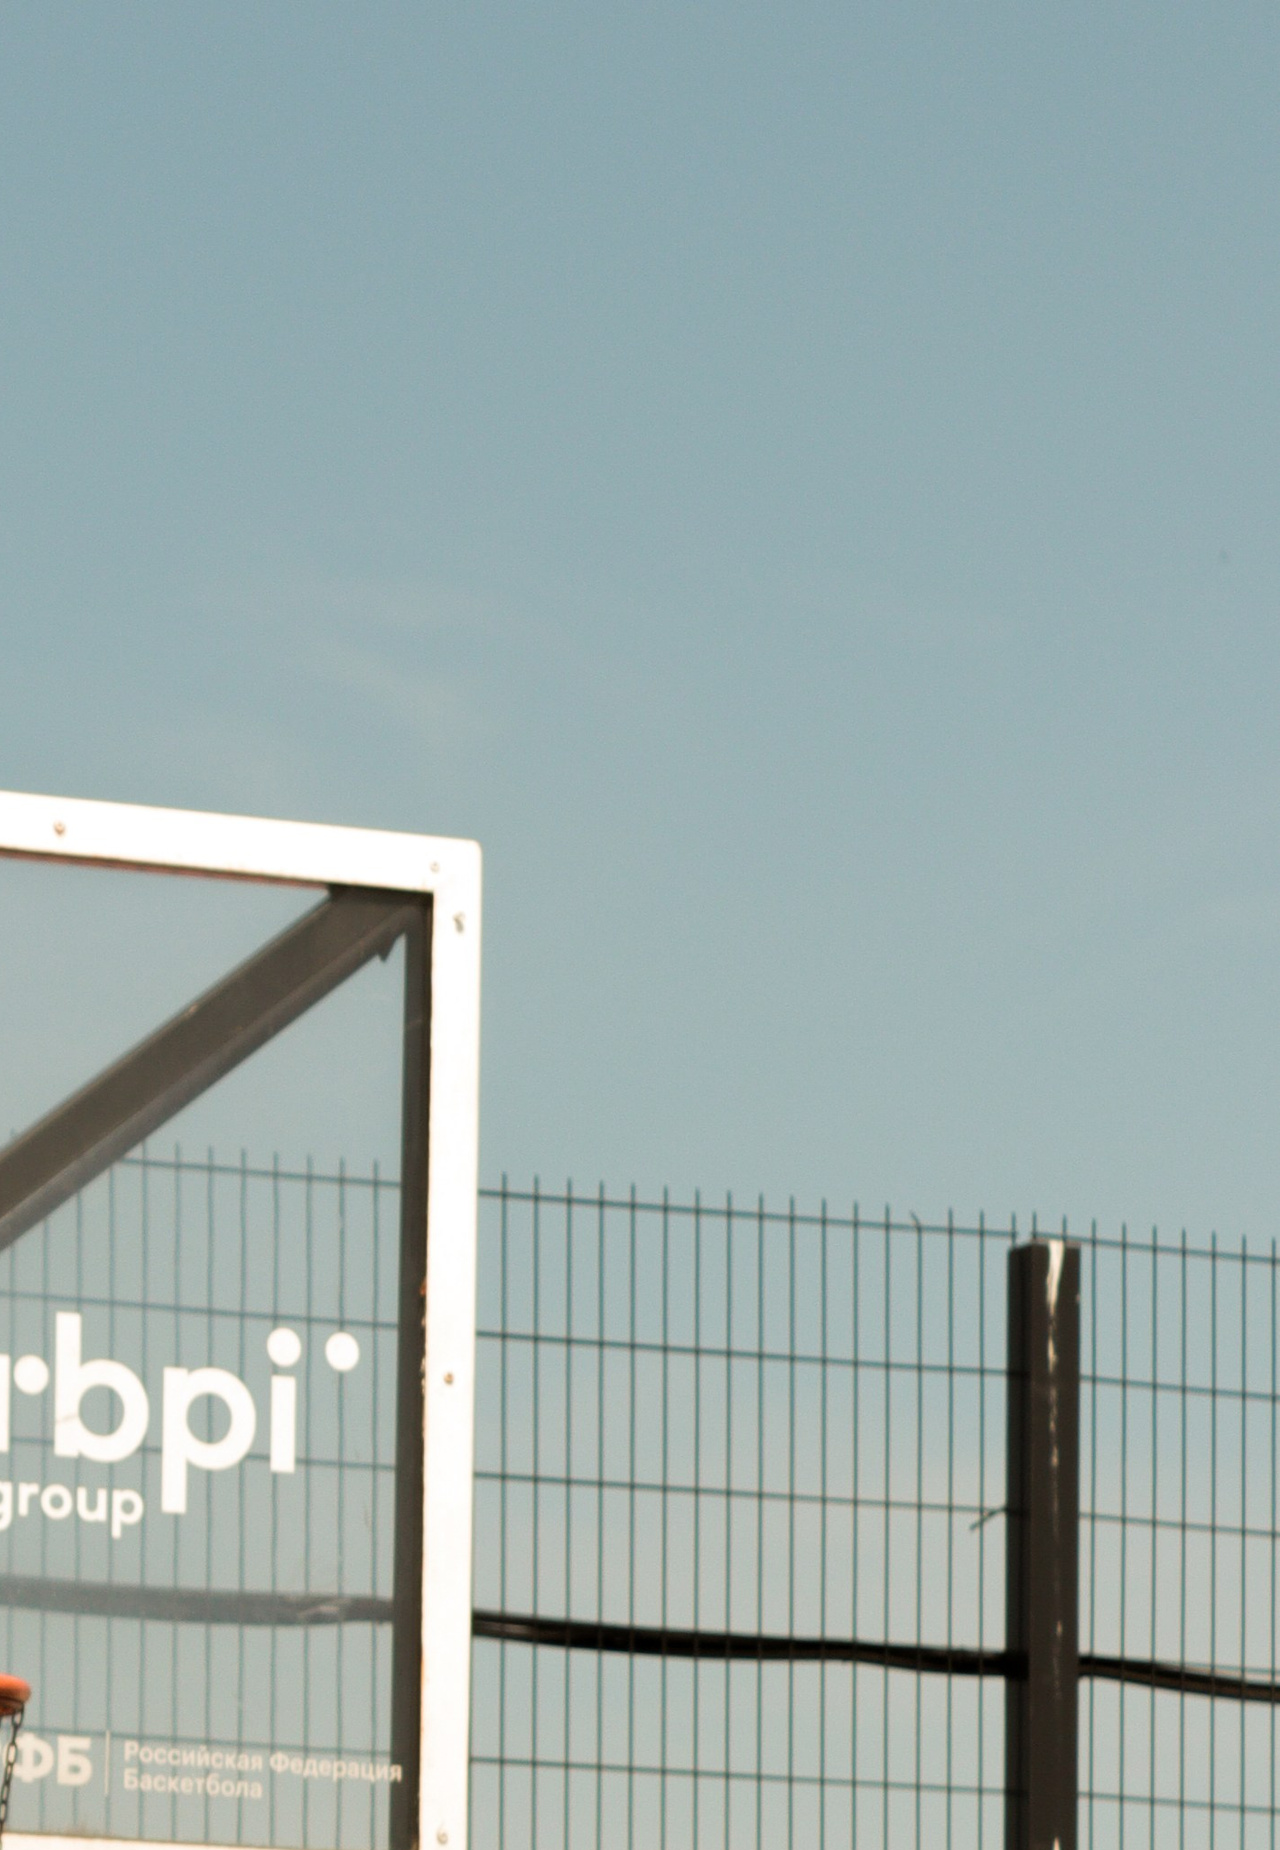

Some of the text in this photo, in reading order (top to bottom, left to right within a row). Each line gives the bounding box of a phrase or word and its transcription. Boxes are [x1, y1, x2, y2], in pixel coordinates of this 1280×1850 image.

[124, 1740, 402, 1783] Российская Федерация
[124, 1767, 263, 1798] Баскетбола
